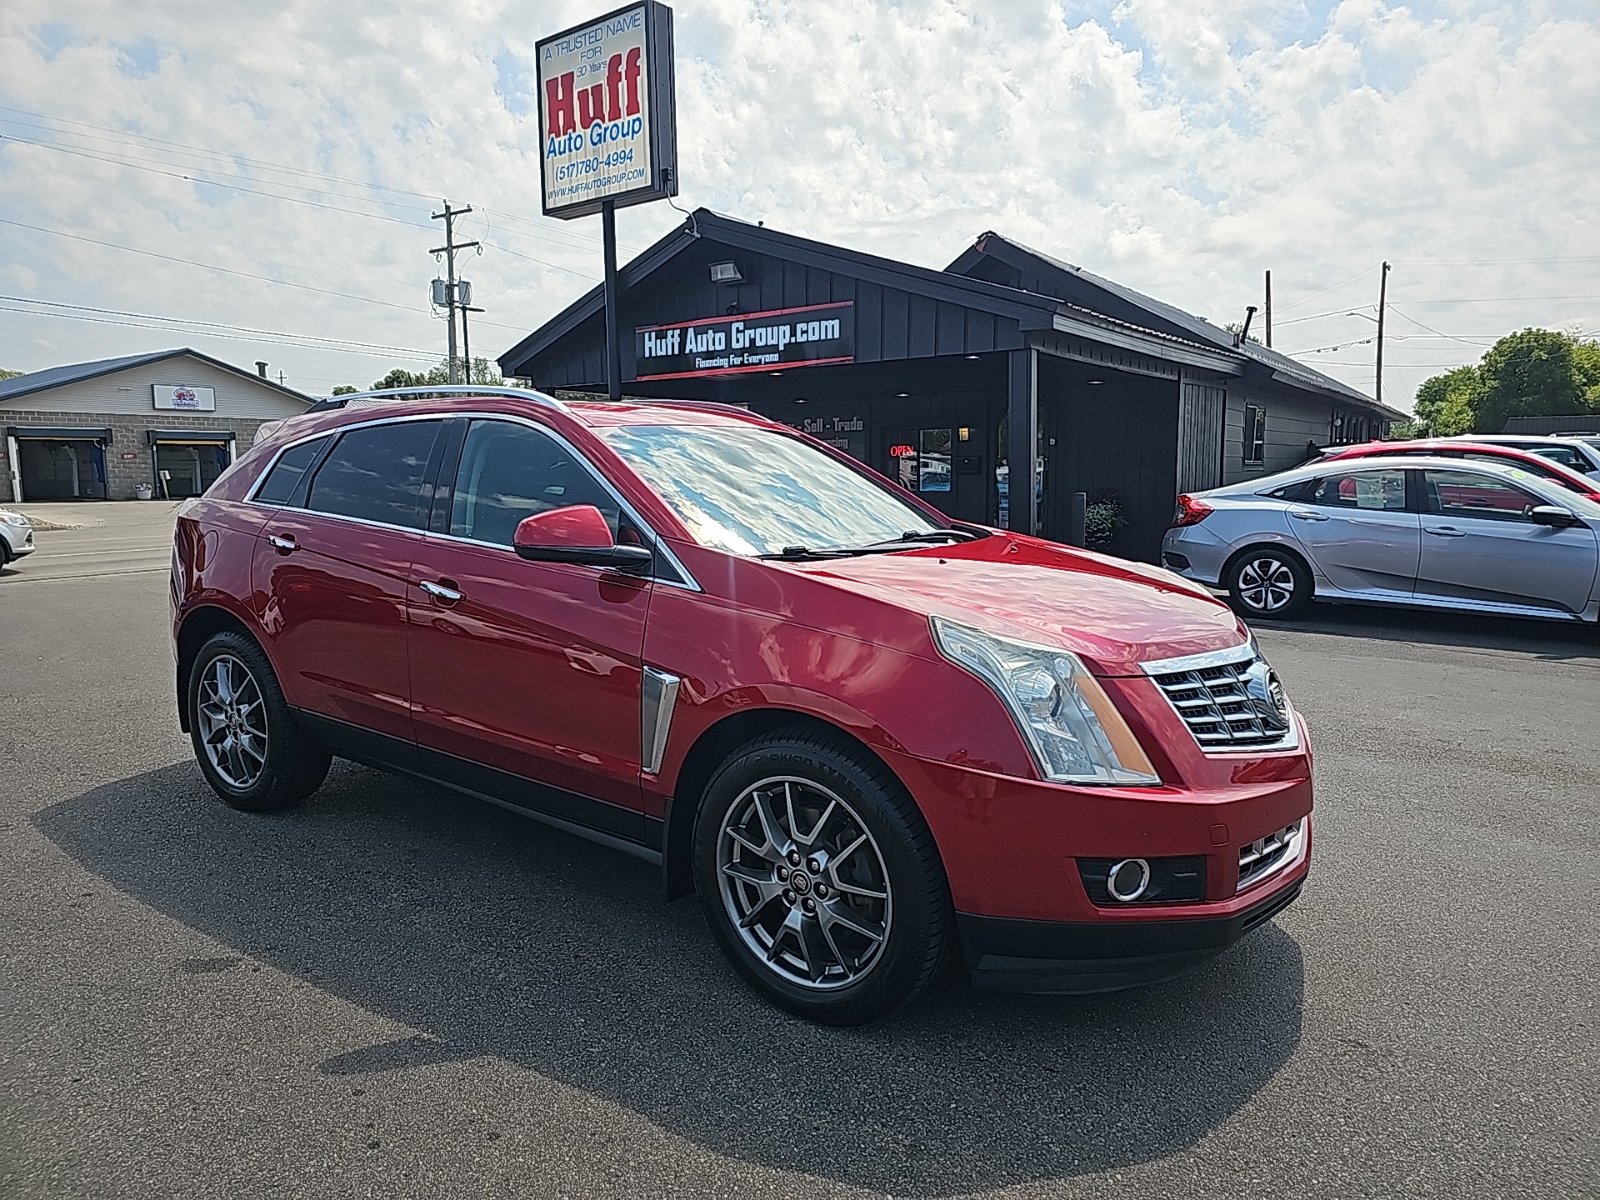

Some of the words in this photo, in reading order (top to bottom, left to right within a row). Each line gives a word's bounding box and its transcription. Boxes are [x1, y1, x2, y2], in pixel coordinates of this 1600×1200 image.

[544, 47, 553, 62] A
[554, 28, 603, 57] TRUSTED
[606, 12, 642, 38] NAME
[580, 45, 602, 62] FOR
[576, 64, 587, 78] 30
[588, 60, 607, 74] Years
[545, 47, 641, 138] Huff
[547, 131, 583, 160] Auto
[589, 116, 642, 147] Group
[555, 147, 634, 182] (517)780-4994
[547, 167, 645, 200] WWW.HUFFAUTOGROUP.COM
[644, 328, 680, 358] Huff
[684, 327, 726, 354] Auto
[731, 317, 841, 350] Group.com
[695, 356, 729, 369] Financing
[729, 354, 743, 366] For
[744, 352, 779, 365] Everyone
[803, 418, 823, 433] Sell
[832, 416, 863, 432] Trade
[890, 445, 914, 457] OPEN
